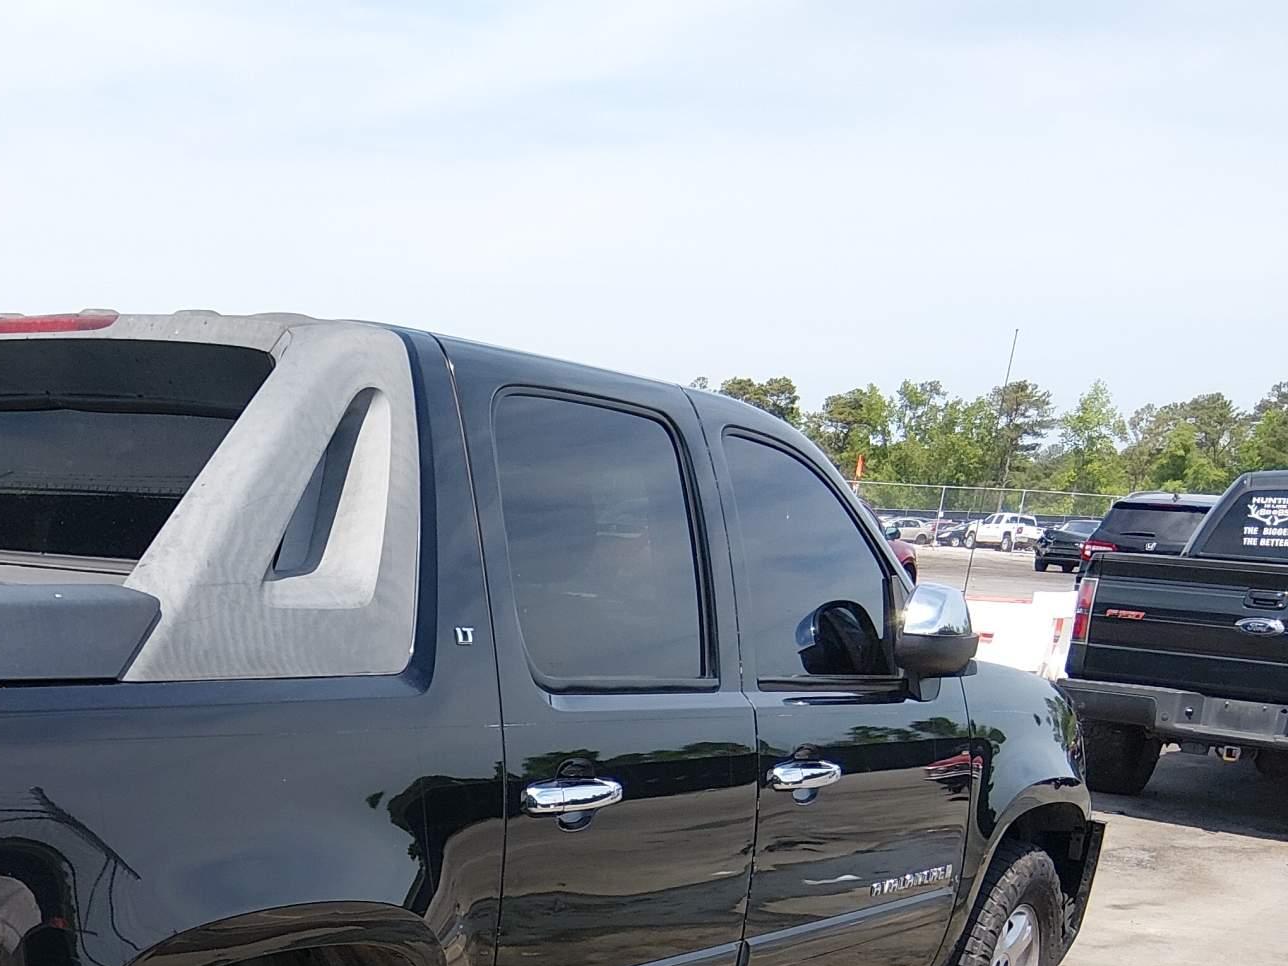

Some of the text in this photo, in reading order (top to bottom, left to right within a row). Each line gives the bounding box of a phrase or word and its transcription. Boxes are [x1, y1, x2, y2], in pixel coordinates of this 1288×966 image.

[1252, 496, 1288, 504] HUNTI
[1243, 526, 1259, 535] THE
[1243, 537, 1258, 546] THE
[455, 626, 474, 645] LT
